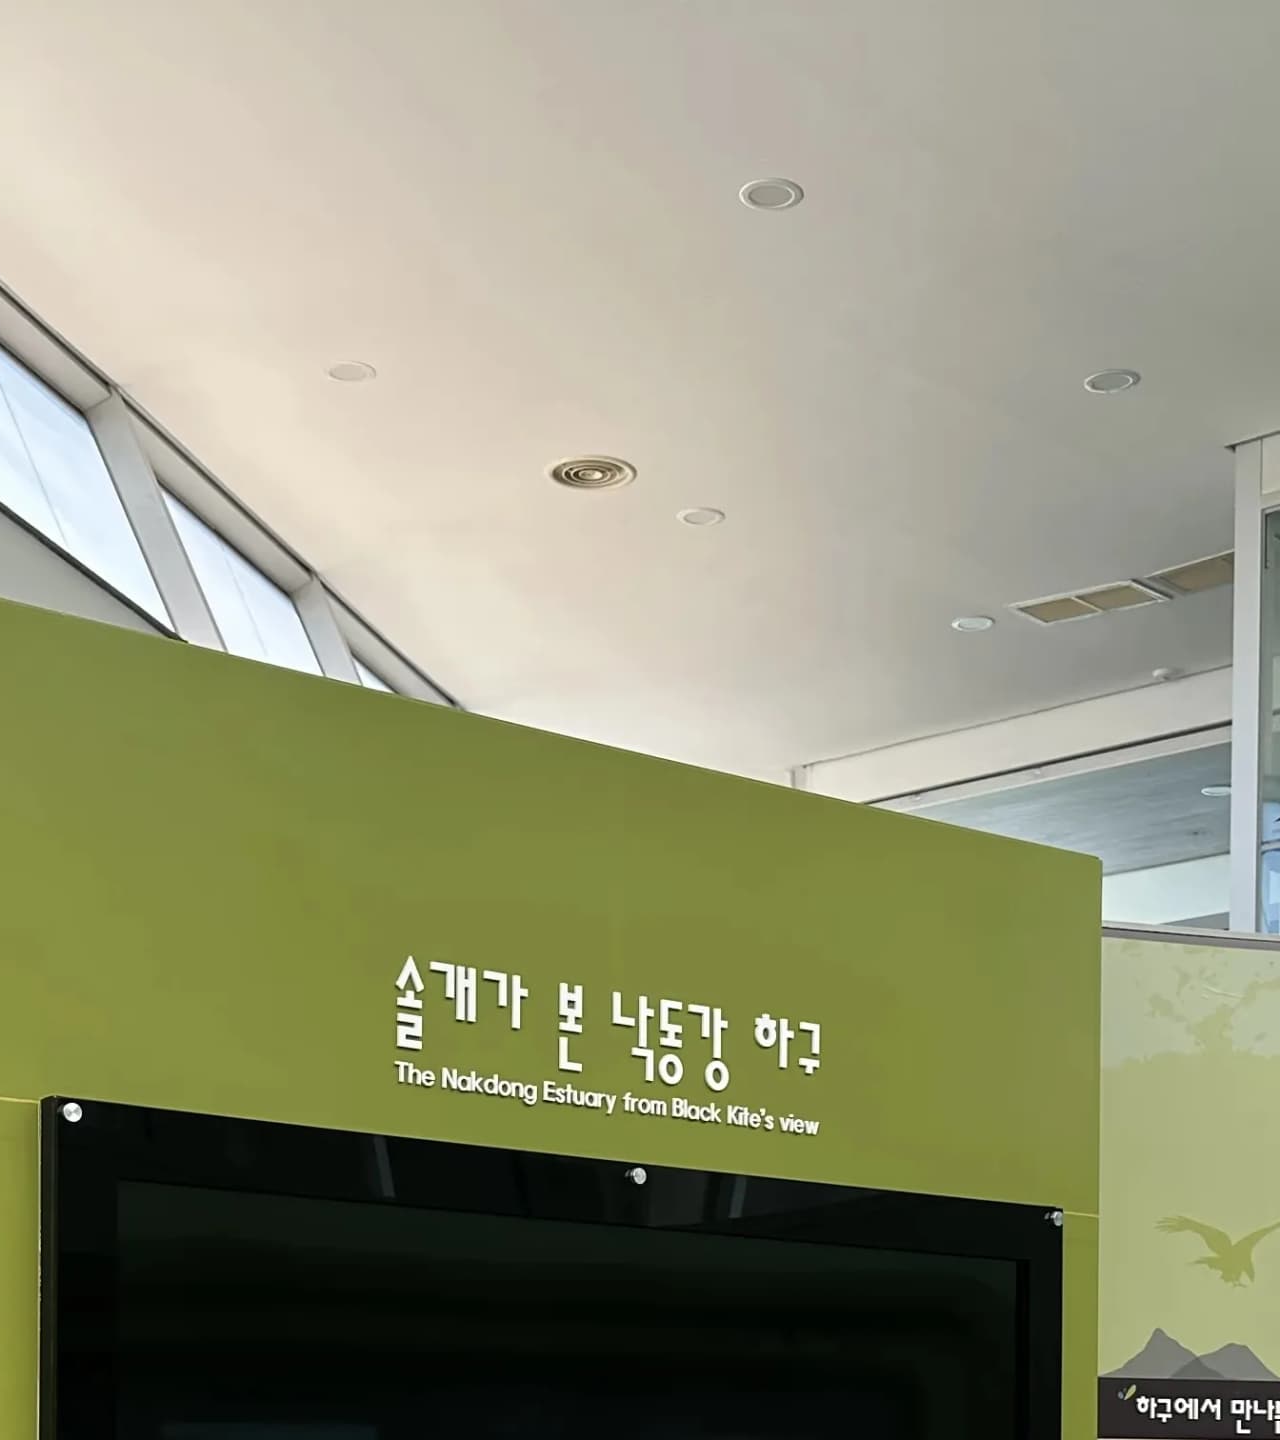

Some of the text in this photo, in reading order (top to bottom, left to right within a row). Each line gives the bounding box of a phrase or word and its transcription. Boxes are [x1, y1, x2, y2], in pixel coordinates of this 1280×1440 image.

[396, 956, 820, 1090] 솔개가 본 낙동강 하구
[394, 1061, 435, 1086] The
[442, 1068, 537, 1104] Nakdong
[543, 1081, 616, 1113] Estuary
[623, 1092, 667, 1115] from
[672, 1098, 721, 1122] Black
[779, 1114, 819, 1134] view
[1137, 1396, 1220, 1422] 하구에서
